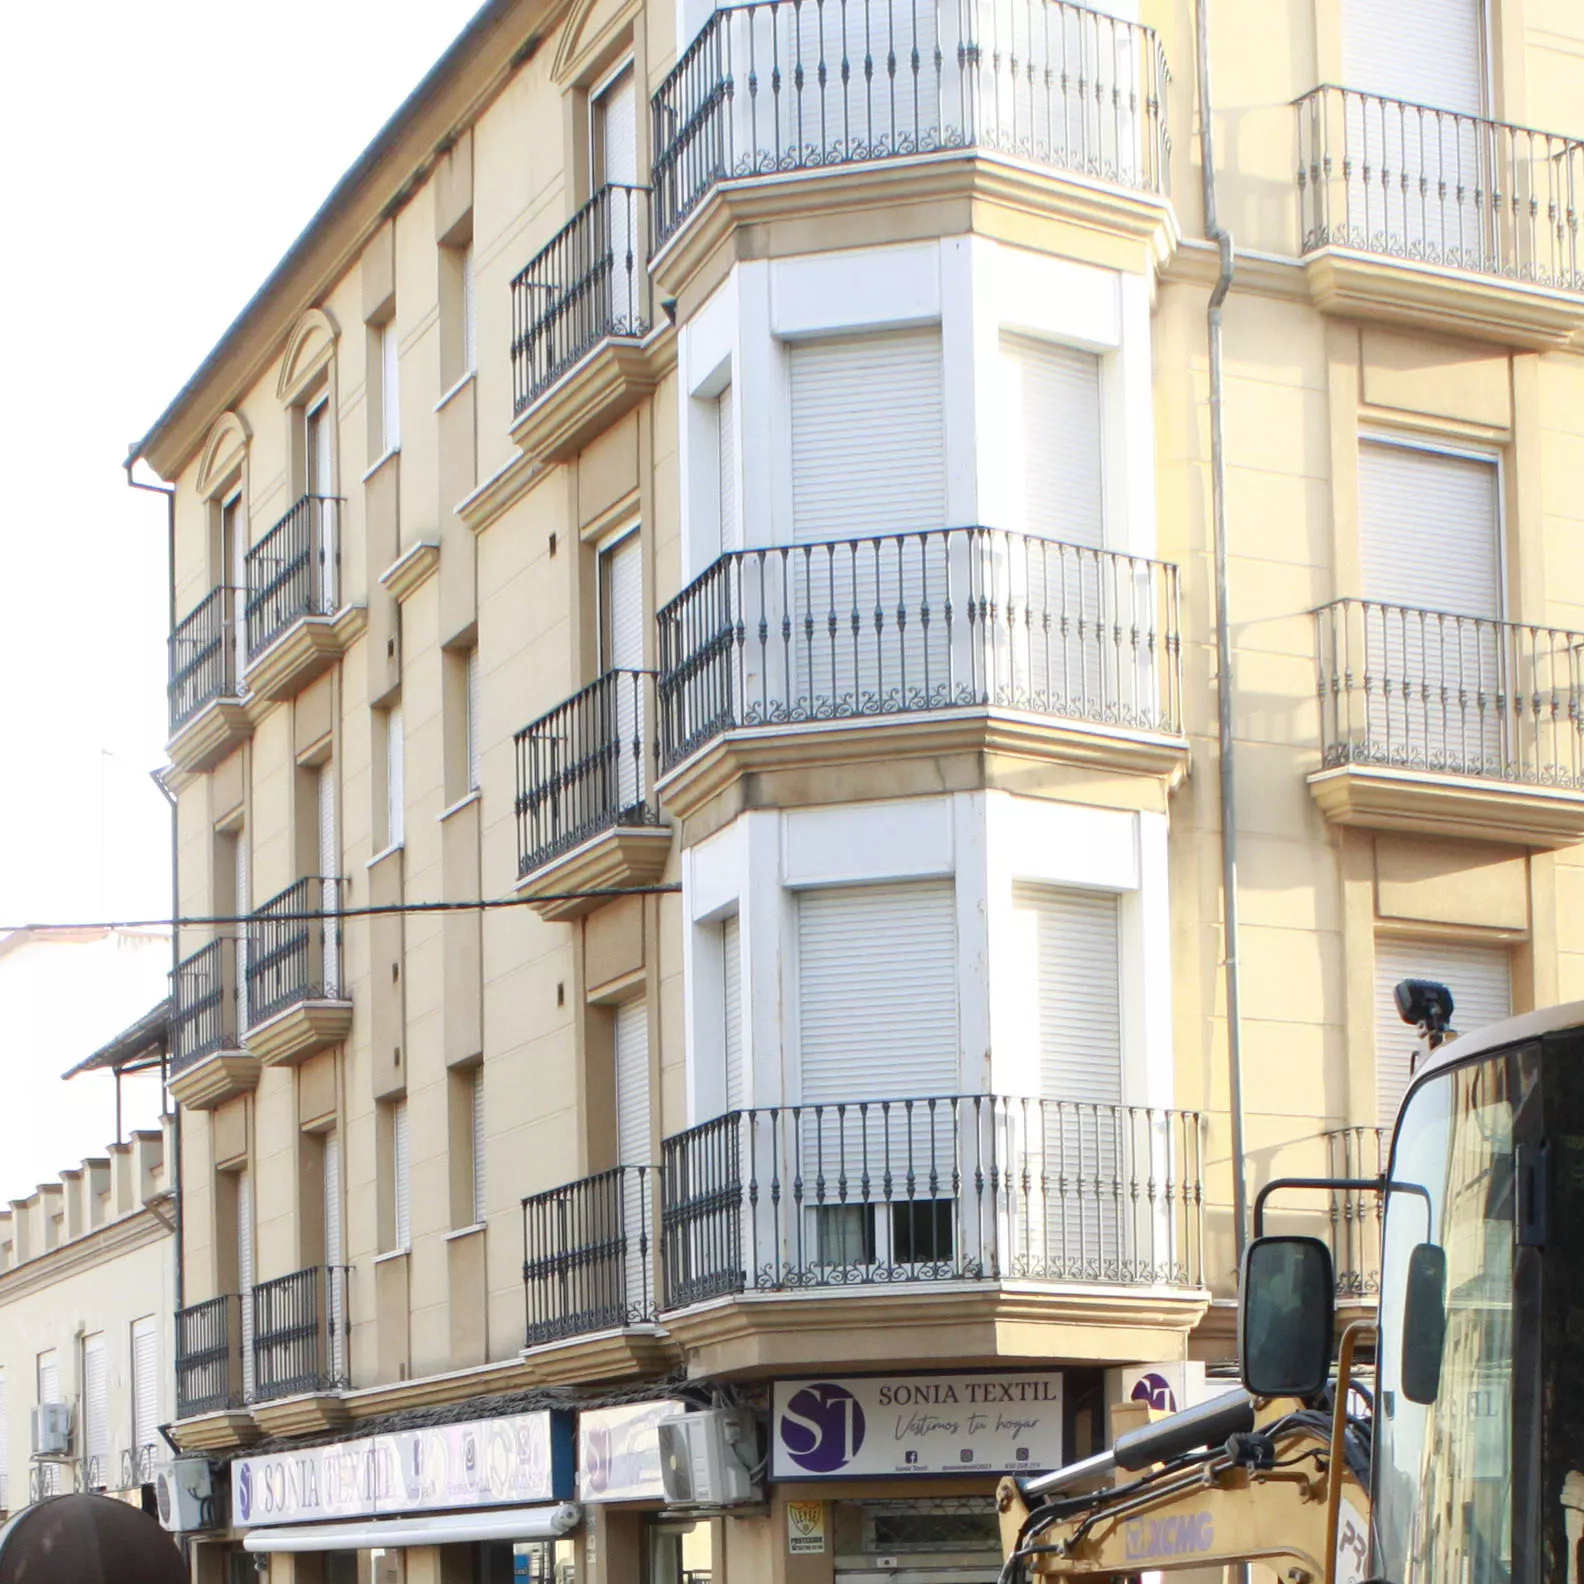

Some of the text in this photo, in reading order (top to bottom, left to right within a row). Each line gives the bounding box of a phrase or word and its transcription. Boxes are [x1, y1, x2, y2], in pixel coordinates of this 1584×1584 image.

[879, 1381, 1057, 1407] SONIA TEXTIL
[895, 1412, 959, 1441] Vestimos
[995, 1413, 1040, 1440] hogar
[265, 1442, 394, 1513] SONIA TEXTIL
[1148, 1511, 1214, 1557] XCMG
